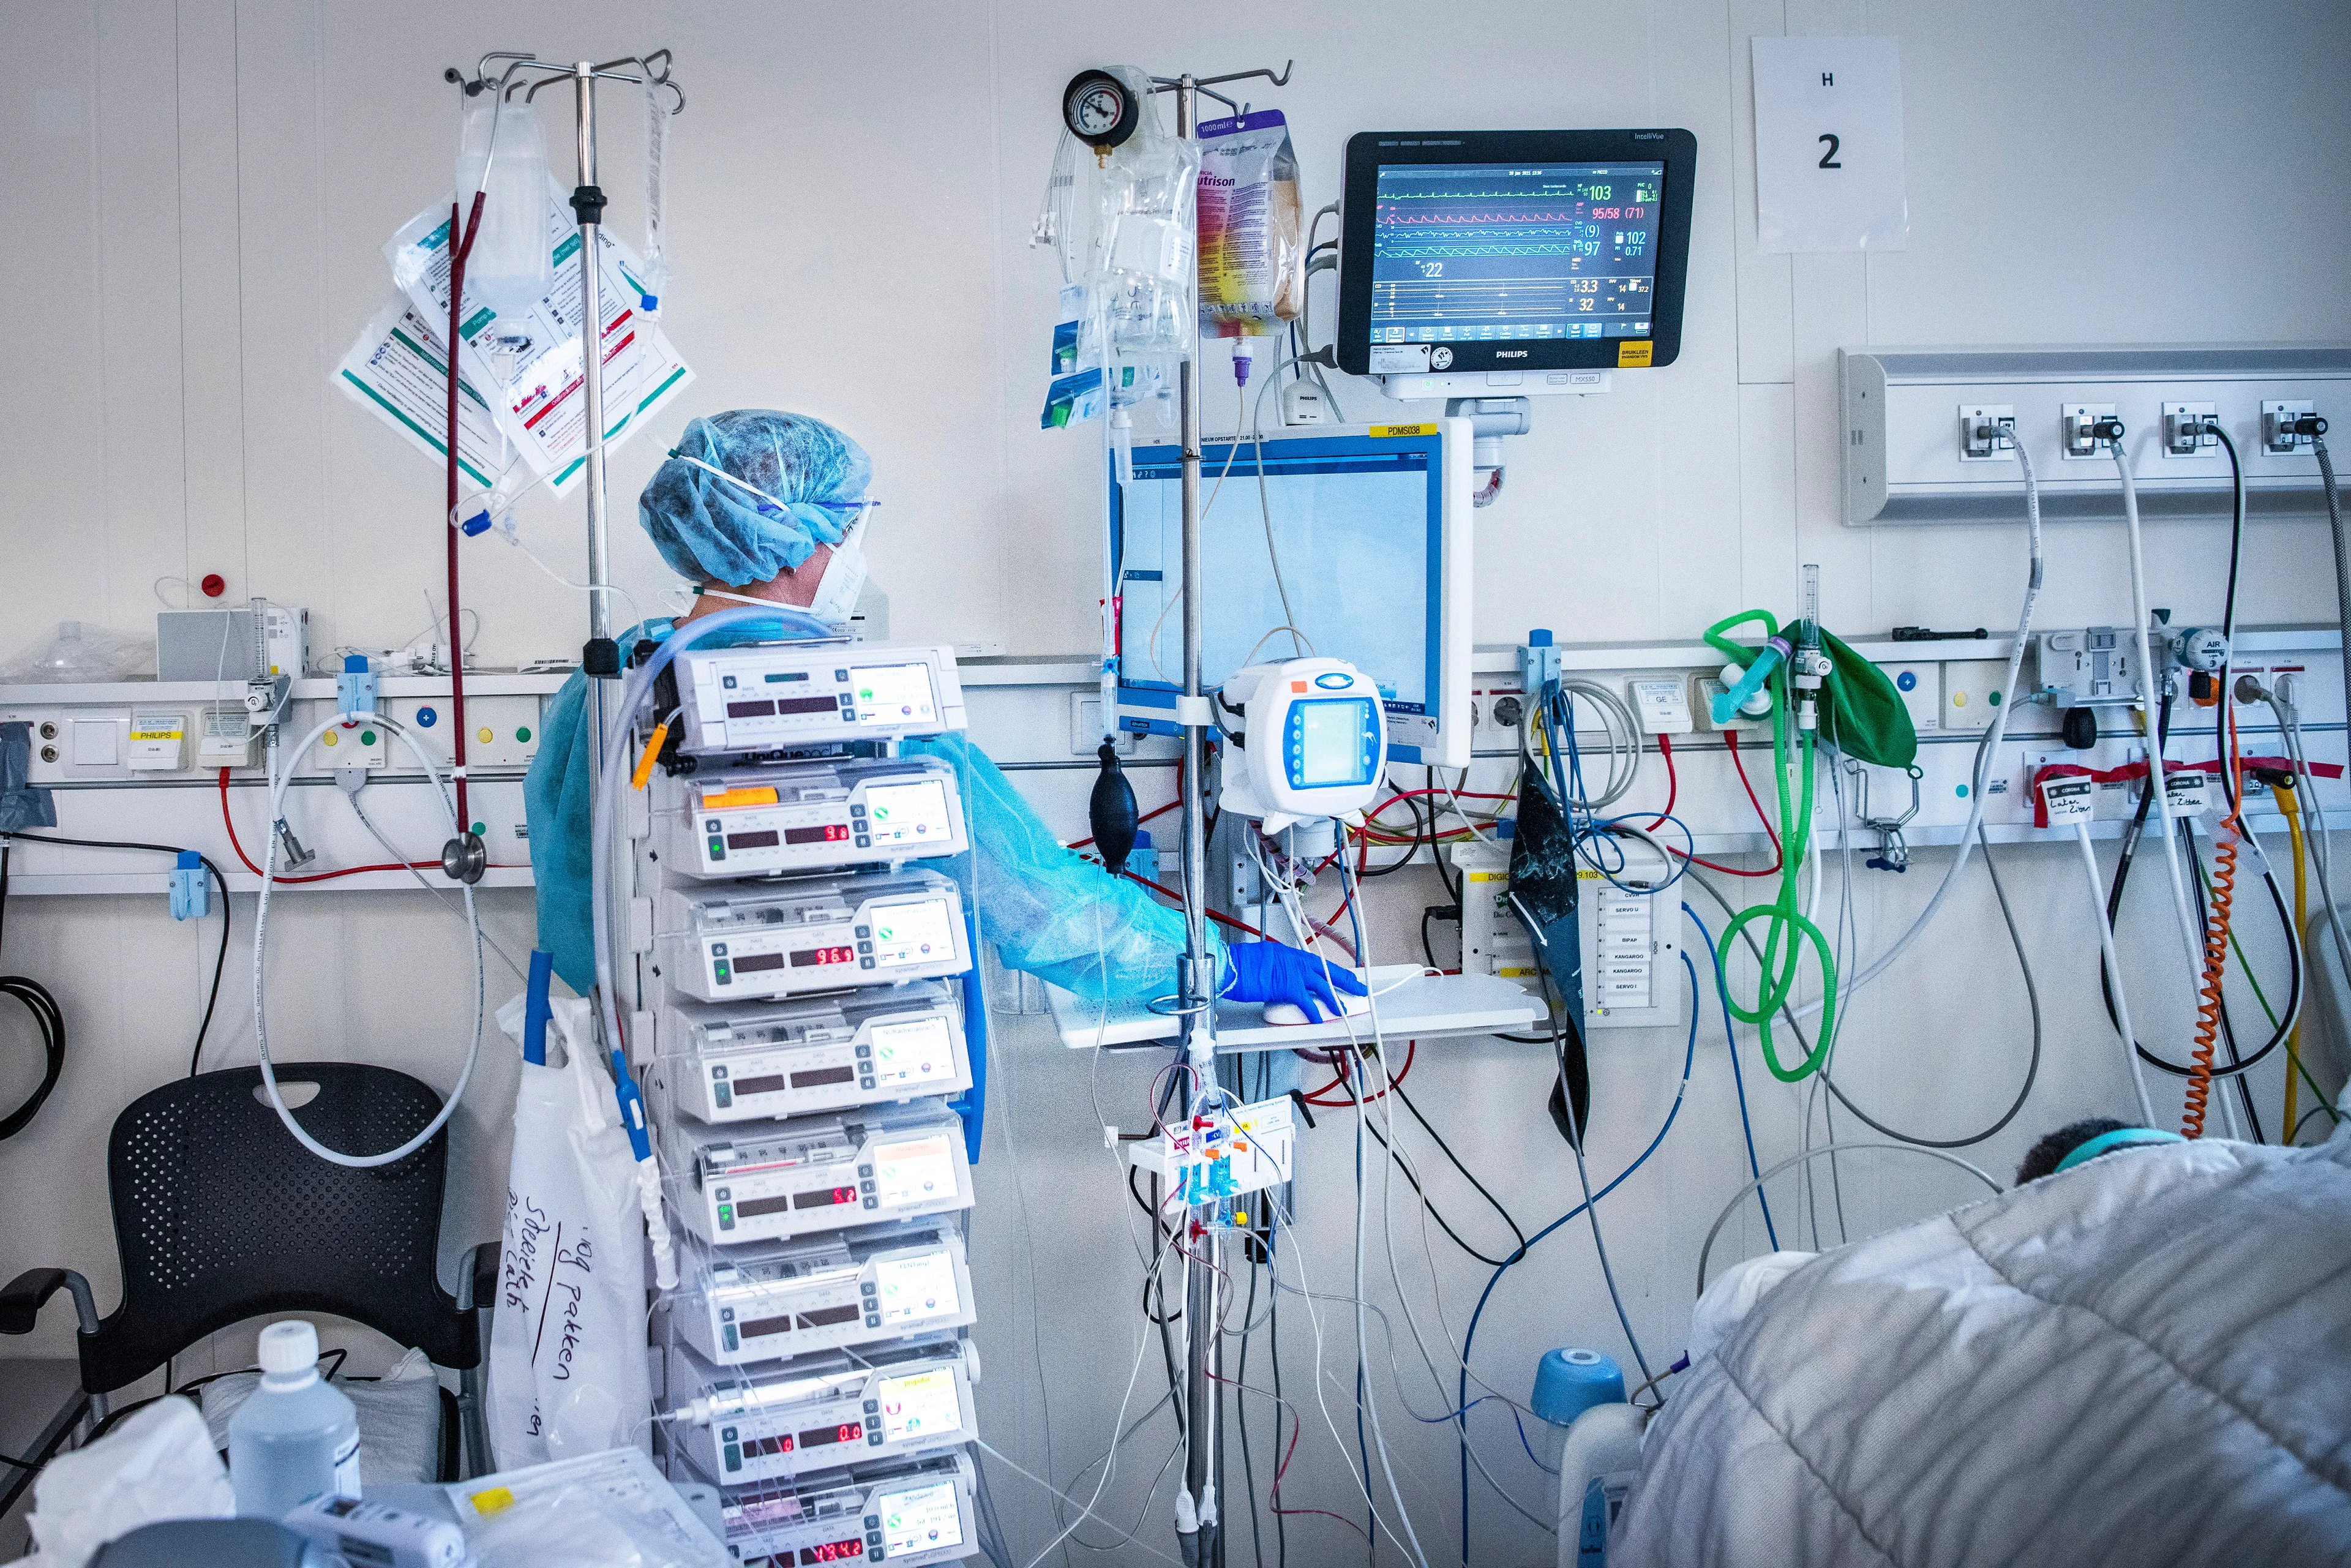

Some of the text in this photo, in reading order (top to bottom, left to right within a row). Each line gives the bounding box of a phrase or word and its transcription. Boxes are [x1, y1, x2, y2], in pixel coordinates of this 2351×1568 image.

[1822, 72, 1834, 87] H
[1201, 124, 1217, 133] 1000
[1818, 133, 1842, 170] 2
[1197, 176, 1235, 187] utrison
[1589, 186, 1611, 201] 103
[1592, 208, 1620, 219] 95/58
[1625, 207, 1644, 219] (71)
[1584, 225, 1600, 238] (9)
[1626, 231, 1646, 245] 102
[1584, 241, 1600, 256] 97
[1625, 246, 1642, 256] 0.71
[1425, 263, 1442, 277] 22
[1580, 280, 1598, 293] 3.3
[1578, 298, 1594, 311] 32
[1388, 426, 1420, 435] PDMS038
[257, 912, 266, 961] Antistatisch
[271, 840, 276, 849] EN
[883, 1026, 929, 1035] NORadrenaline
[904, 1376, 930, 1387] propofol
[783, 1438, 793, 1452] 0
